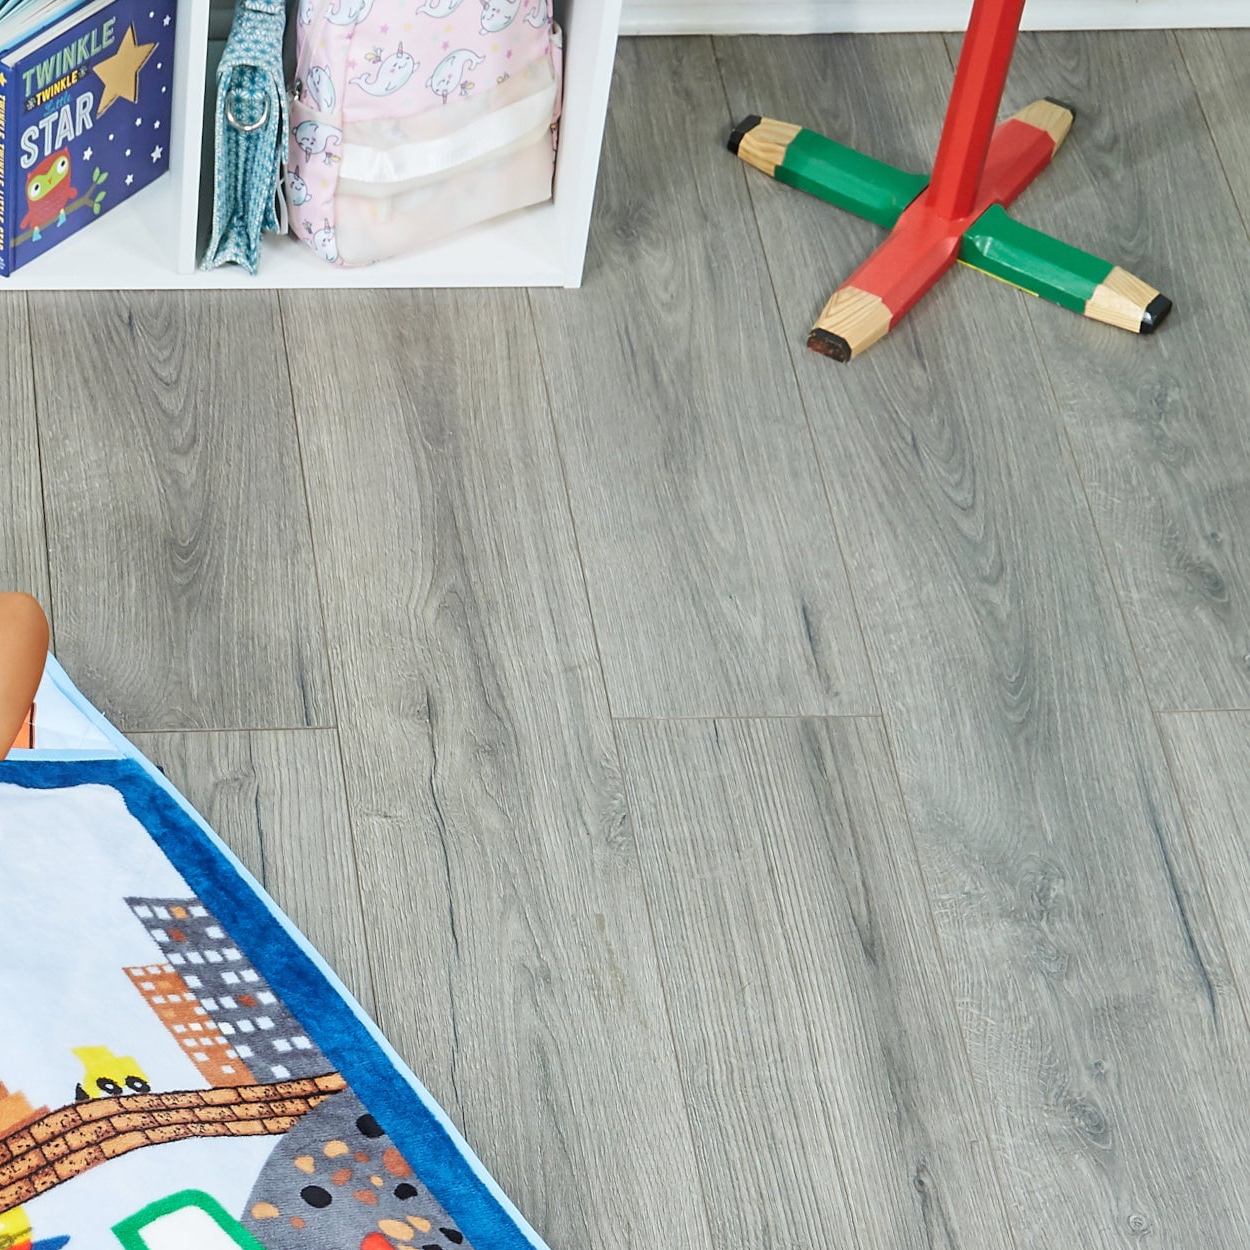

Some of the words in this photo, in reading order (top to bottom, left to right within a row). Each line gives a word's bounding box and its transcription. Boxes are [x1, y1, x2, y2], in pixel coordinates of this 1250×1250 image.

[22, 16, 116, 97] TWINKLE
[35, 70, 78, 106] TWINKLE
[20, 91, 94, 169] STAR
